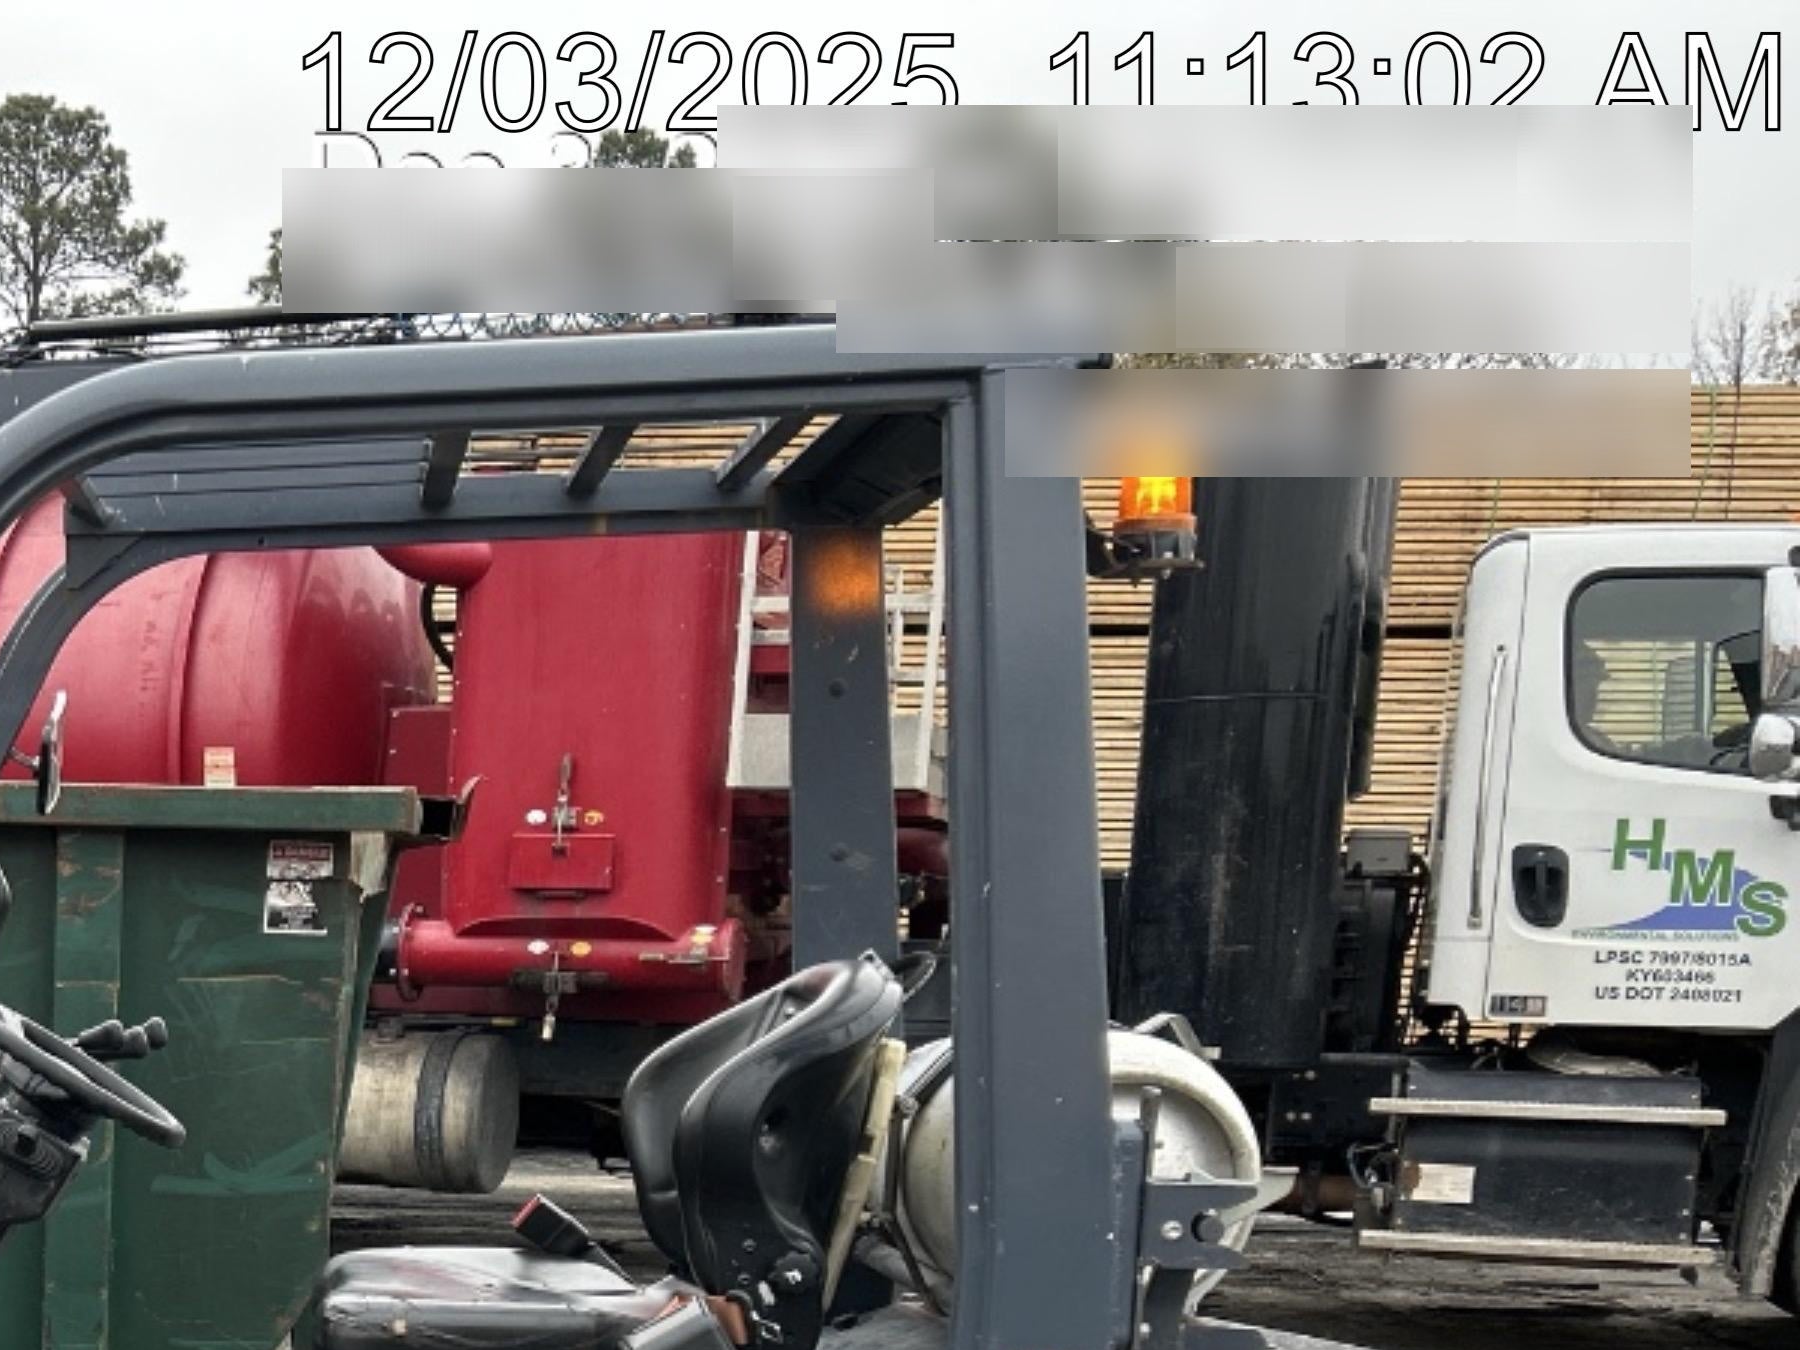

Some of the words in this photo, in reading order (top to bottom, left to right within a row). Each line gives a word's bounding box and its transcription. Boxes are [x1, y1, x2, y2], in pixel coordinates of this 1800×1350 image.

[1611, 817, 1790, 937] HMS
[1594, 950, 1643, 965] LPSC
[1594, 986, 1621, 1000] US
[1624, 987, 1665, 1001] DOT
